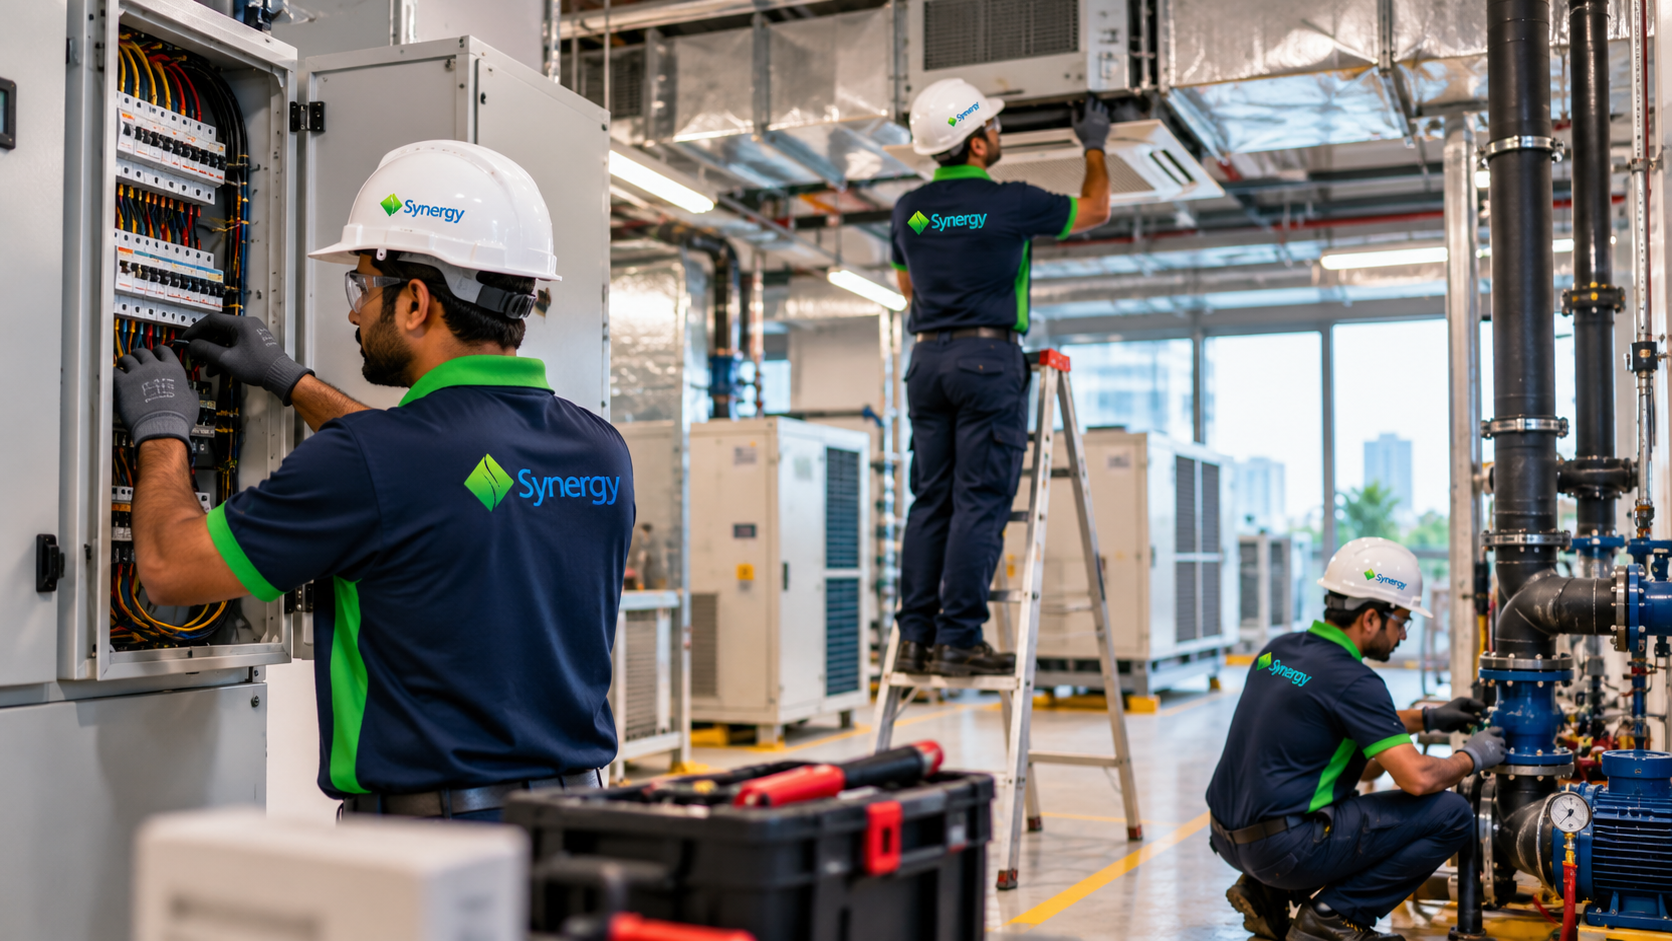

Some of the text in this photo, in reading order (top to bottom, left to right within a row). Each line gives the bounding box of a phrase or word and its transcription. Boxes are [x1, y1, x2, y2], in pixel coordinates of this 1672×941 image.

[403, 199, 466, 224] Synergy
[931, 213, 987, 232] Synergy
[517, 468, 620, 507] Synergy
[1375, 573, 1407, 591] Synergy
